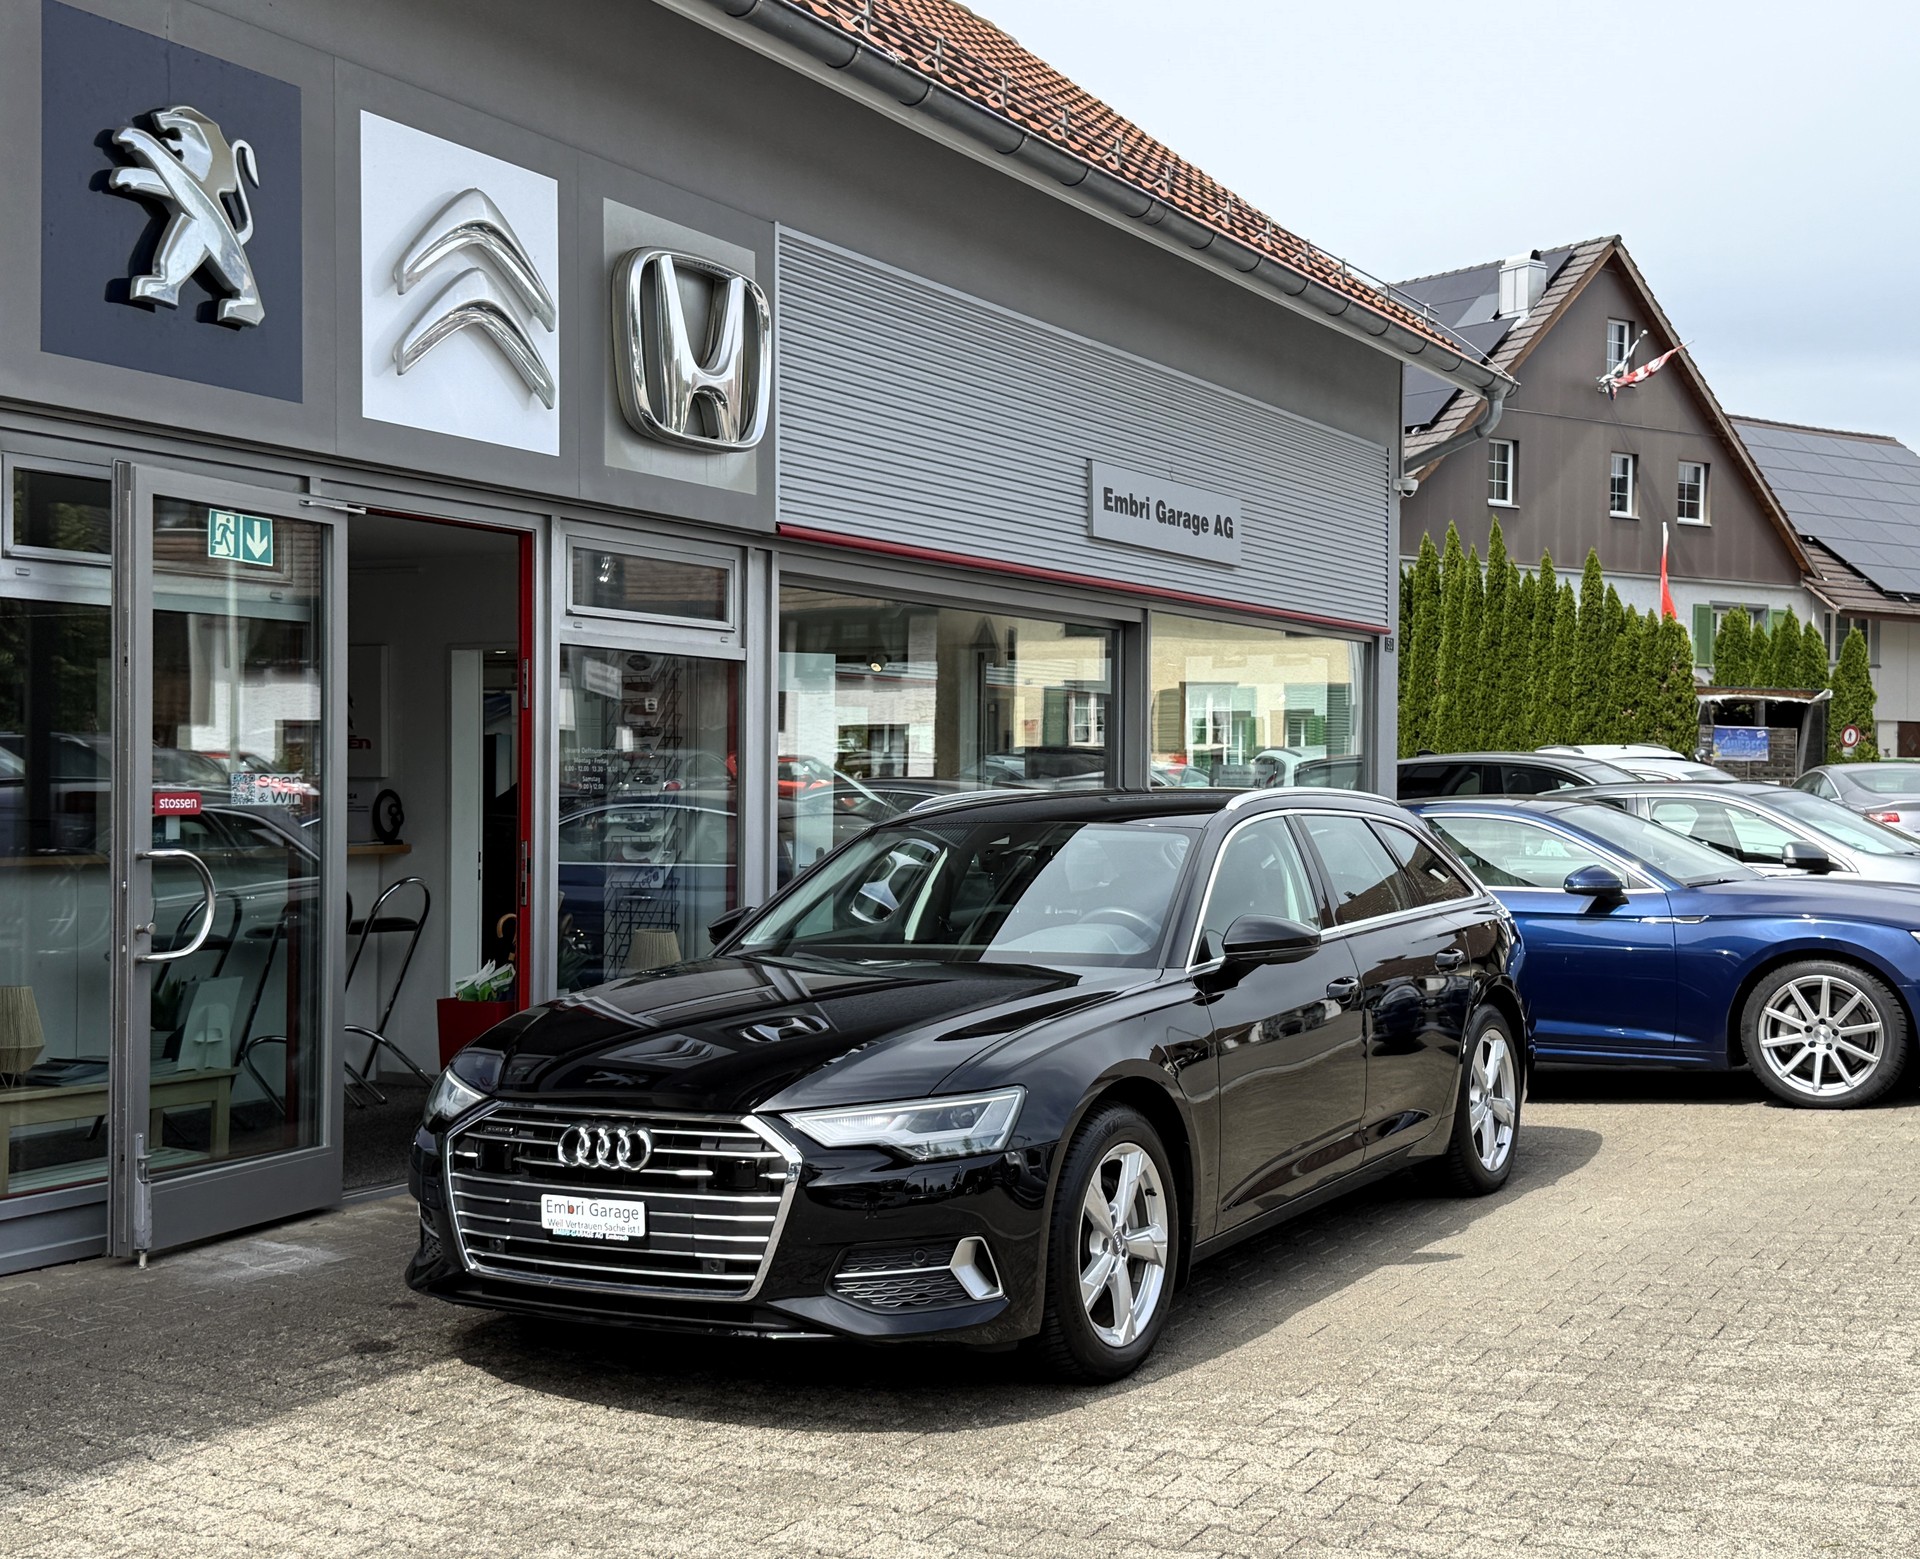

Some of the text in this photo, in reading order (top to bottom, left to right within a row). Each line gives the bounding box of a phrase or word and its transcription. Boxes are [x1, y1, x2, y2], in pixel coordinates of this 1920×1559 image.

[1103, 486, 1234, 539] Embri Garage AG
[159, 797, 197, 809] stossen
[258, 790, 302, 804] & Win
[546, 1199, 639, 1223] Embri Garage
[547, 1218, 564, 1227] Weil
[565, 1219, 602, 1231] Vertrauen
[604, 1222, 626, 1232] Sache
[627, 1224, 636, 1234] ist
